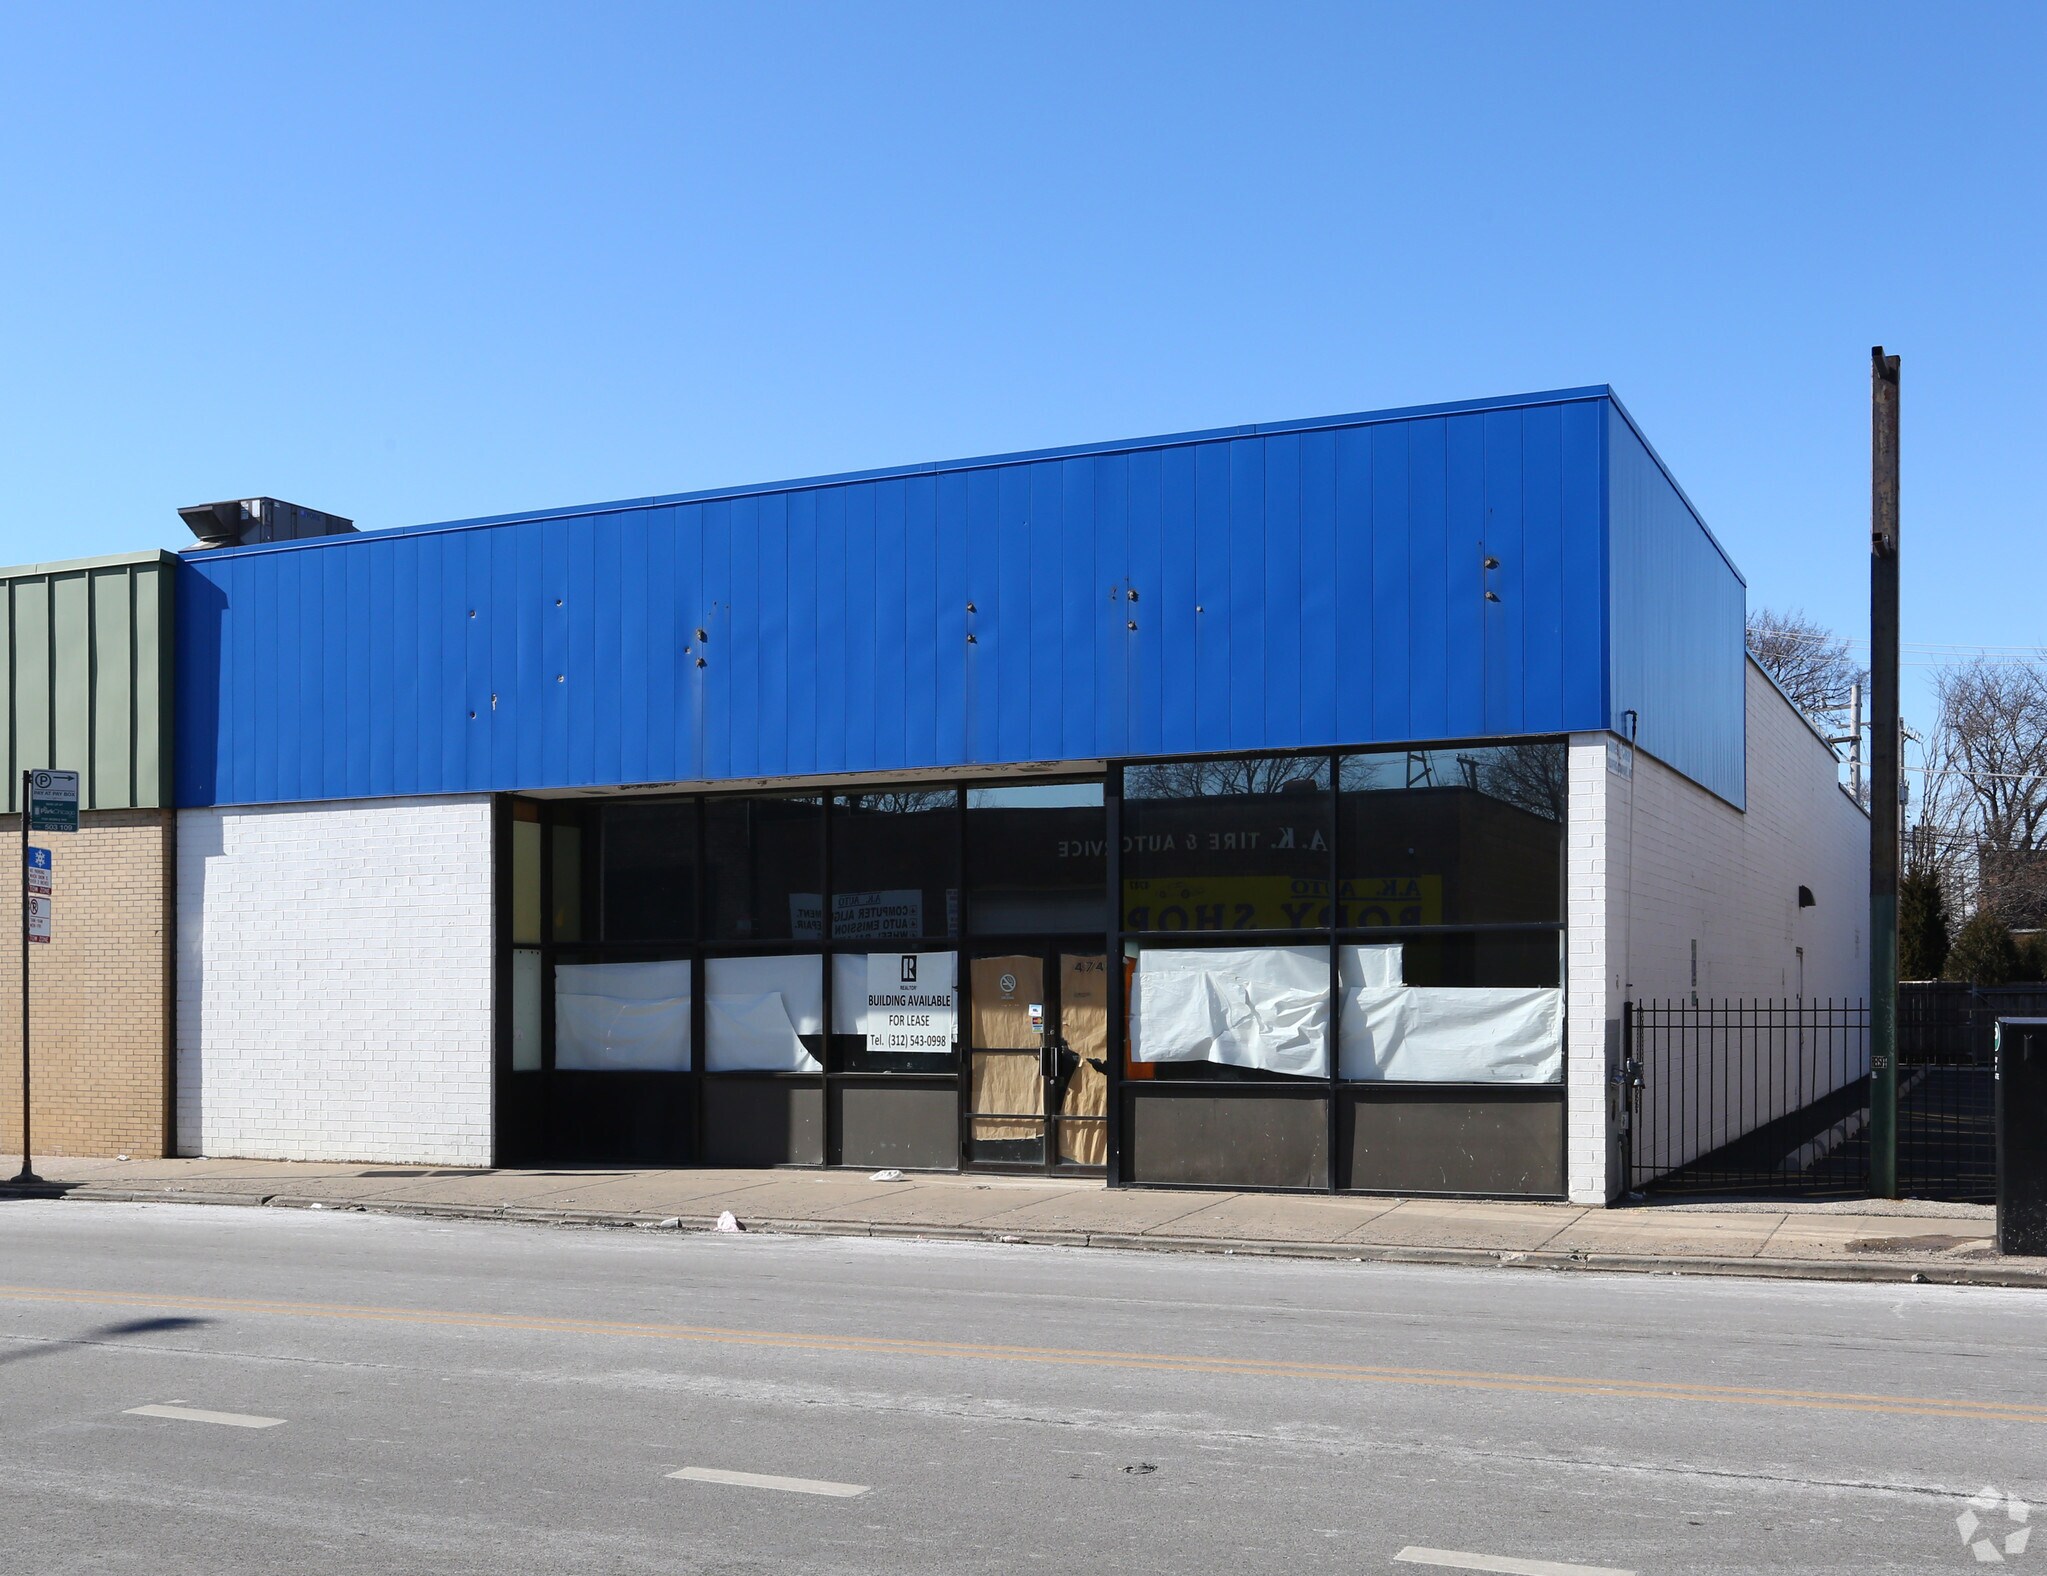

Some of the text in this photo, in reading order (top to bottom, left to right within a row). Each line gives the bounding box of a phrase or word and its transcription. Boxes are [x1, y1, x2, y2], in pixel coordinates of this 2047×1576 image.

[868, 994, 951, 1007] BUILDING AVAILABLE
[889, 1014, 930, 1027] FOR LEASE
[870, 1034, 946, 1048] Tel. (312) 543-0998
